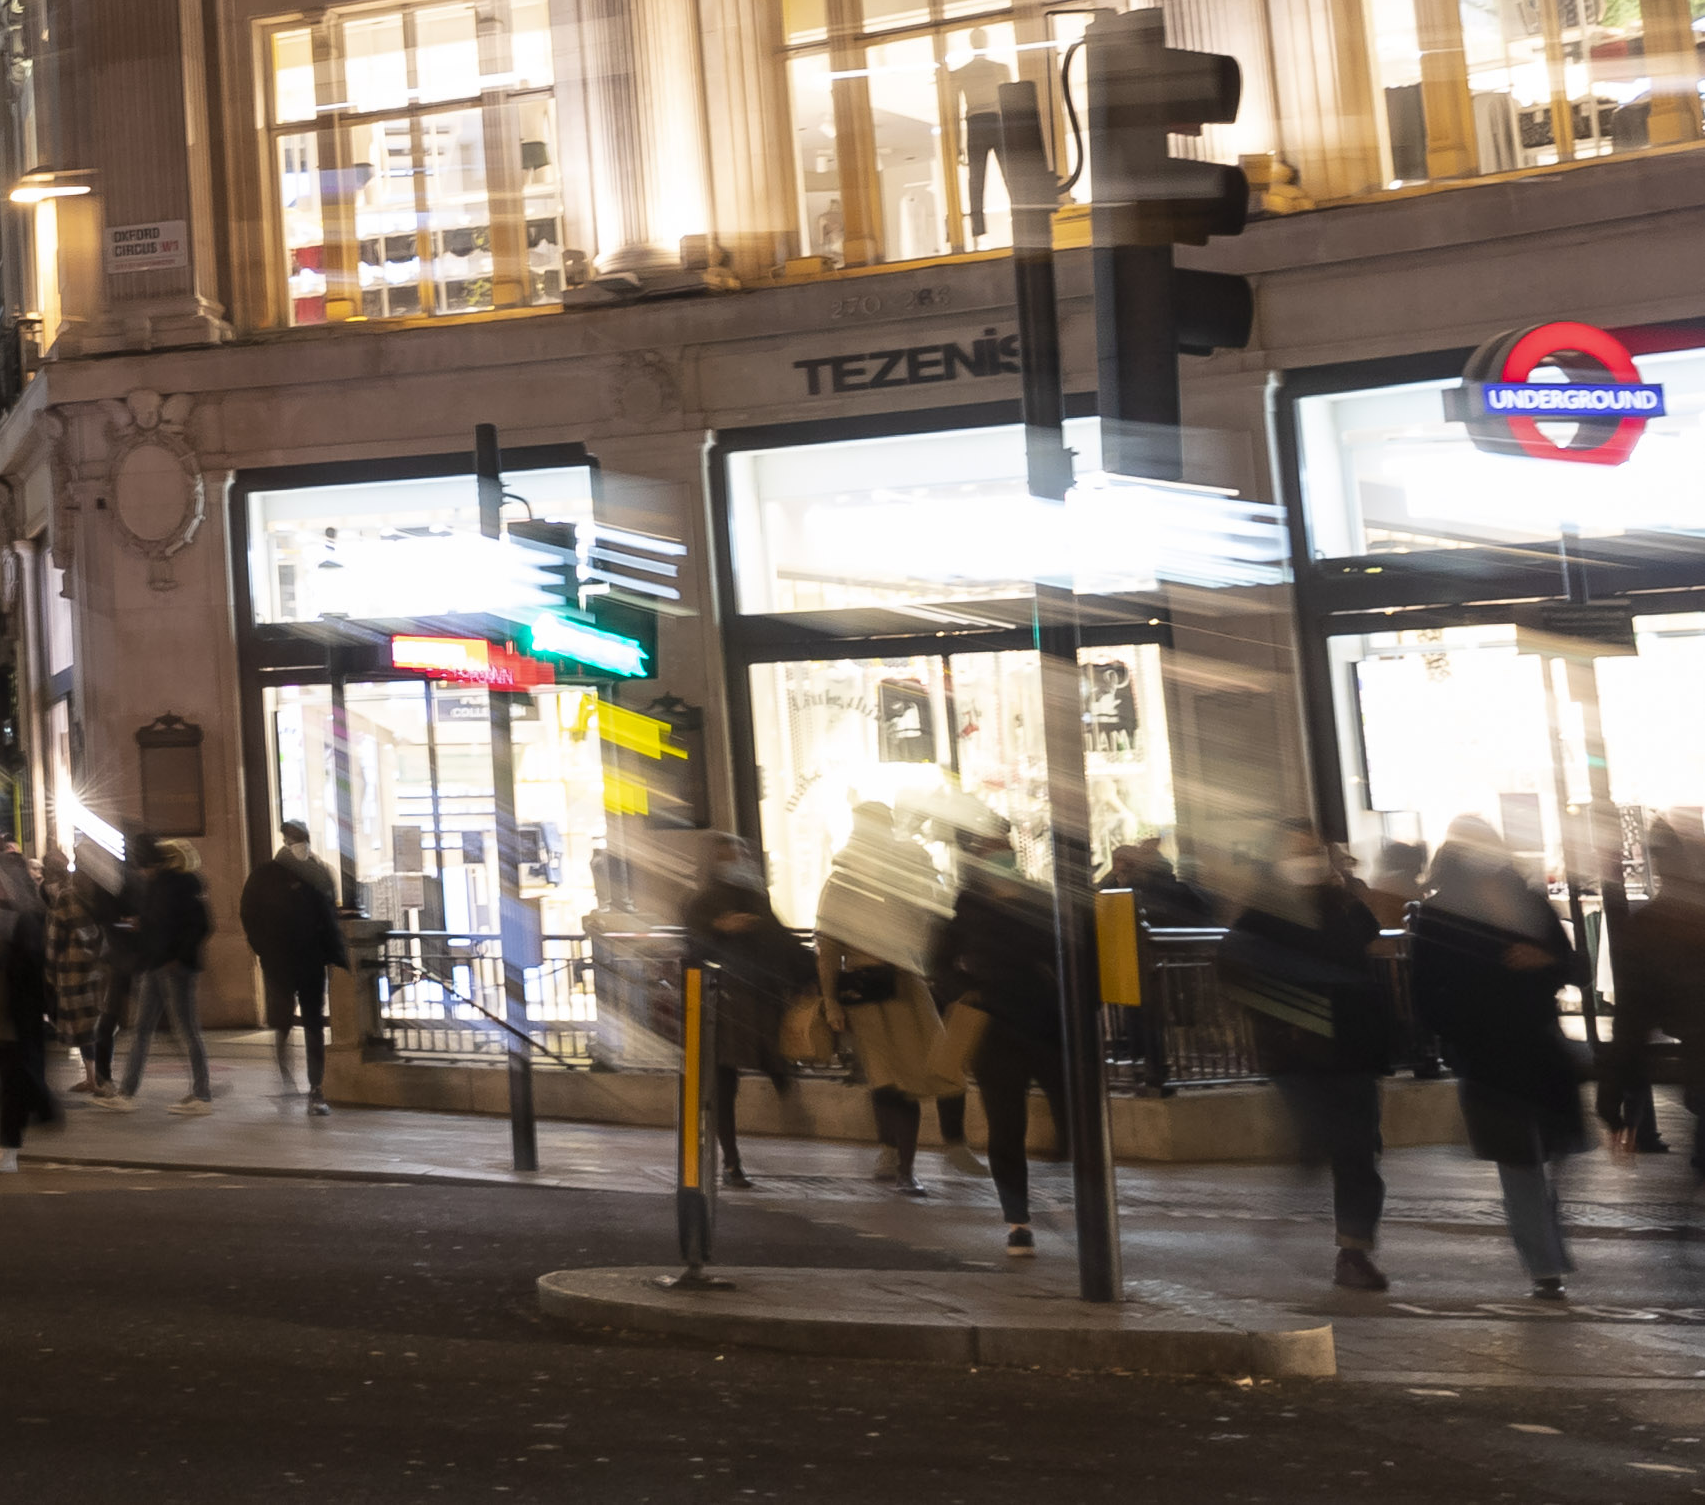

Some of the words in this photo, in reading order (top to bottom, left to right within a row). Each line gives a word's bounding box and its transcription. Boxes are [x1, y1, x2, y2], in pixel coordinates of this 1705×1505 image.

[114, 227, 160, 243] OXFORD
[114, 242, 158, 257] CIRCUS
[1489, 389, 1658, 410] UNDERGROUND
